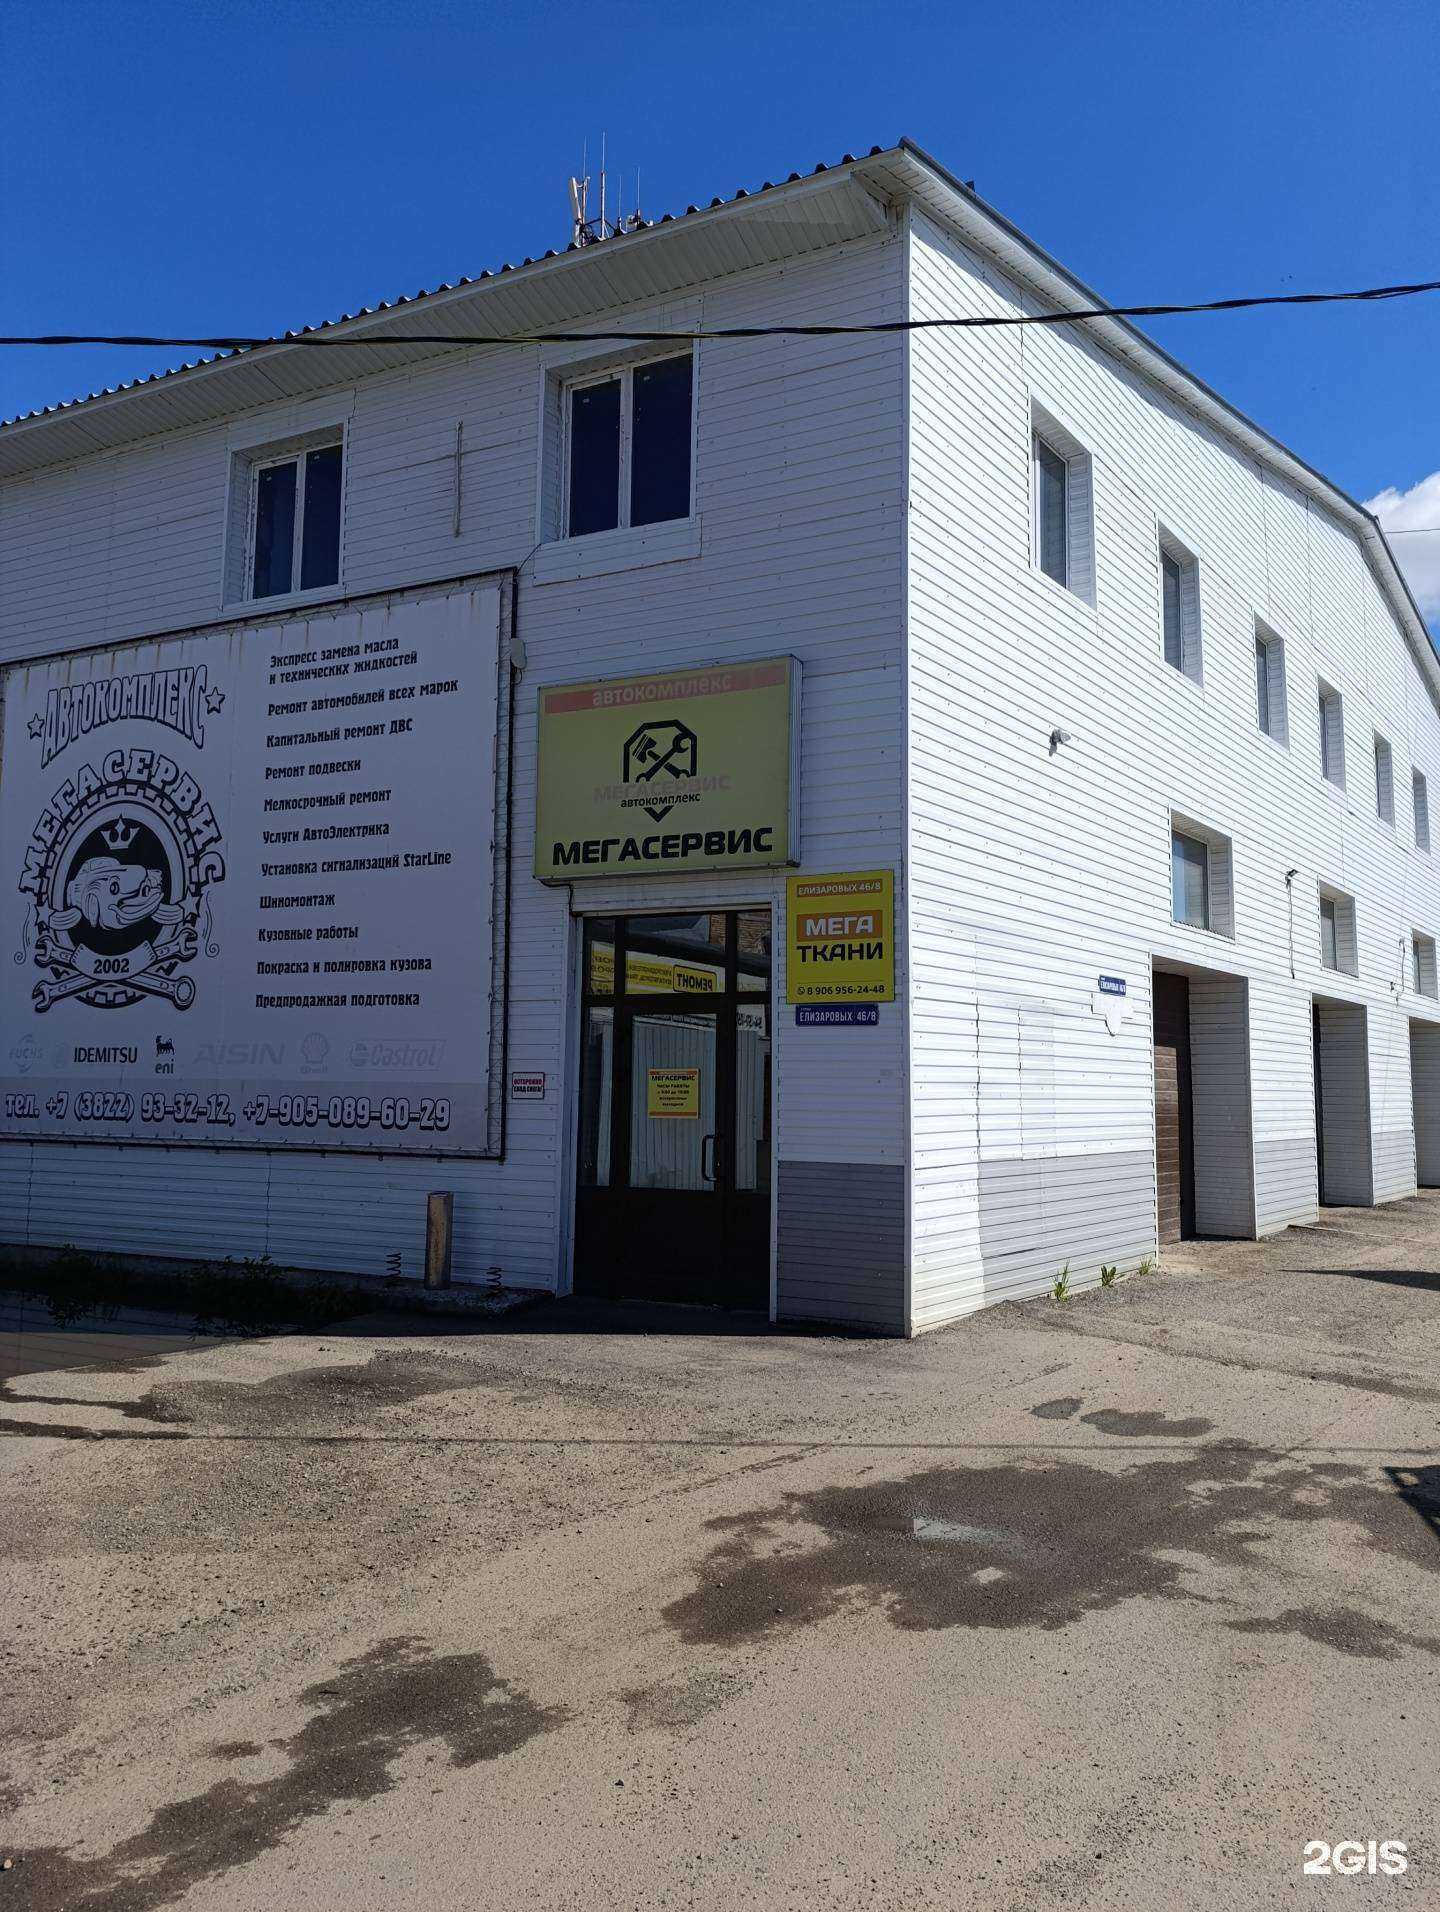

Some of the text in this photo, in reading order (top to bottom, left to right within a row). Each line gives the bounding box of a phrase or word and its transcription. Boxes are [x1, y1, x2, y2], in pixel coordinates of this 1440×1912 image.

[270, 638, 399, 668] Экспресс замена масла
[269, 651, 418, 684] и технических жидкостей
[268, 680, 458, 716] Ремонт автомобилей всех марок
[592, 673, 732, 706] автокомплекс
[41, 664, 208, 769] АВТОКОМПЛЕКС
[266, 718, 413, 748] Капитальный ремонт ДВС
[265, 760, 361, 780] Ремонт подвески
[264, 790, 391, 812] Мелкосрочный ремонт
[621, 793, 701, 808] автокомплекс
[19, 748, 226, 894] МЕГАСЕРВИС
[263, 823, 389, 844] Услуги АвтоЭлектрика
[552, 827, 773, 865] МЕГАСЕРВИС
[261, 852, 451, 876] Установка сигнализаций StarLine
[799, 881, 881, 895] ЕЛИЗАРОВЫХ 46/8
[260, 894, 335, 909] Шиномонтаж
[258, 926, 358, 942] Кузовные работы
[806, 915, 873, 936] МЕГА
[797, 942, 883, 962] ТКАНИ
[93, 958, 130, 974] 2002
[257, 958, 432, 975] Покраска и полировка кузова
[807, 985, 885, 995] 8 906 956-24-48
[255, 993, 420, 1009] Предпродажная подготовка
[800, 1011, 876, 1022] ЕЛИЗАРОВЫХ 46/8
[73, 1047, 138, 1063] IDEMITSU
[155, 1058, 174, 1074] eni
[45, 1091, 69, 1119] +7
[73, 1091, 135, 1123] (3822)
[140, 1093, 236, 1127] 93-32-12,
[243, 1095, 450, 1131] +7-905-089-60-29
